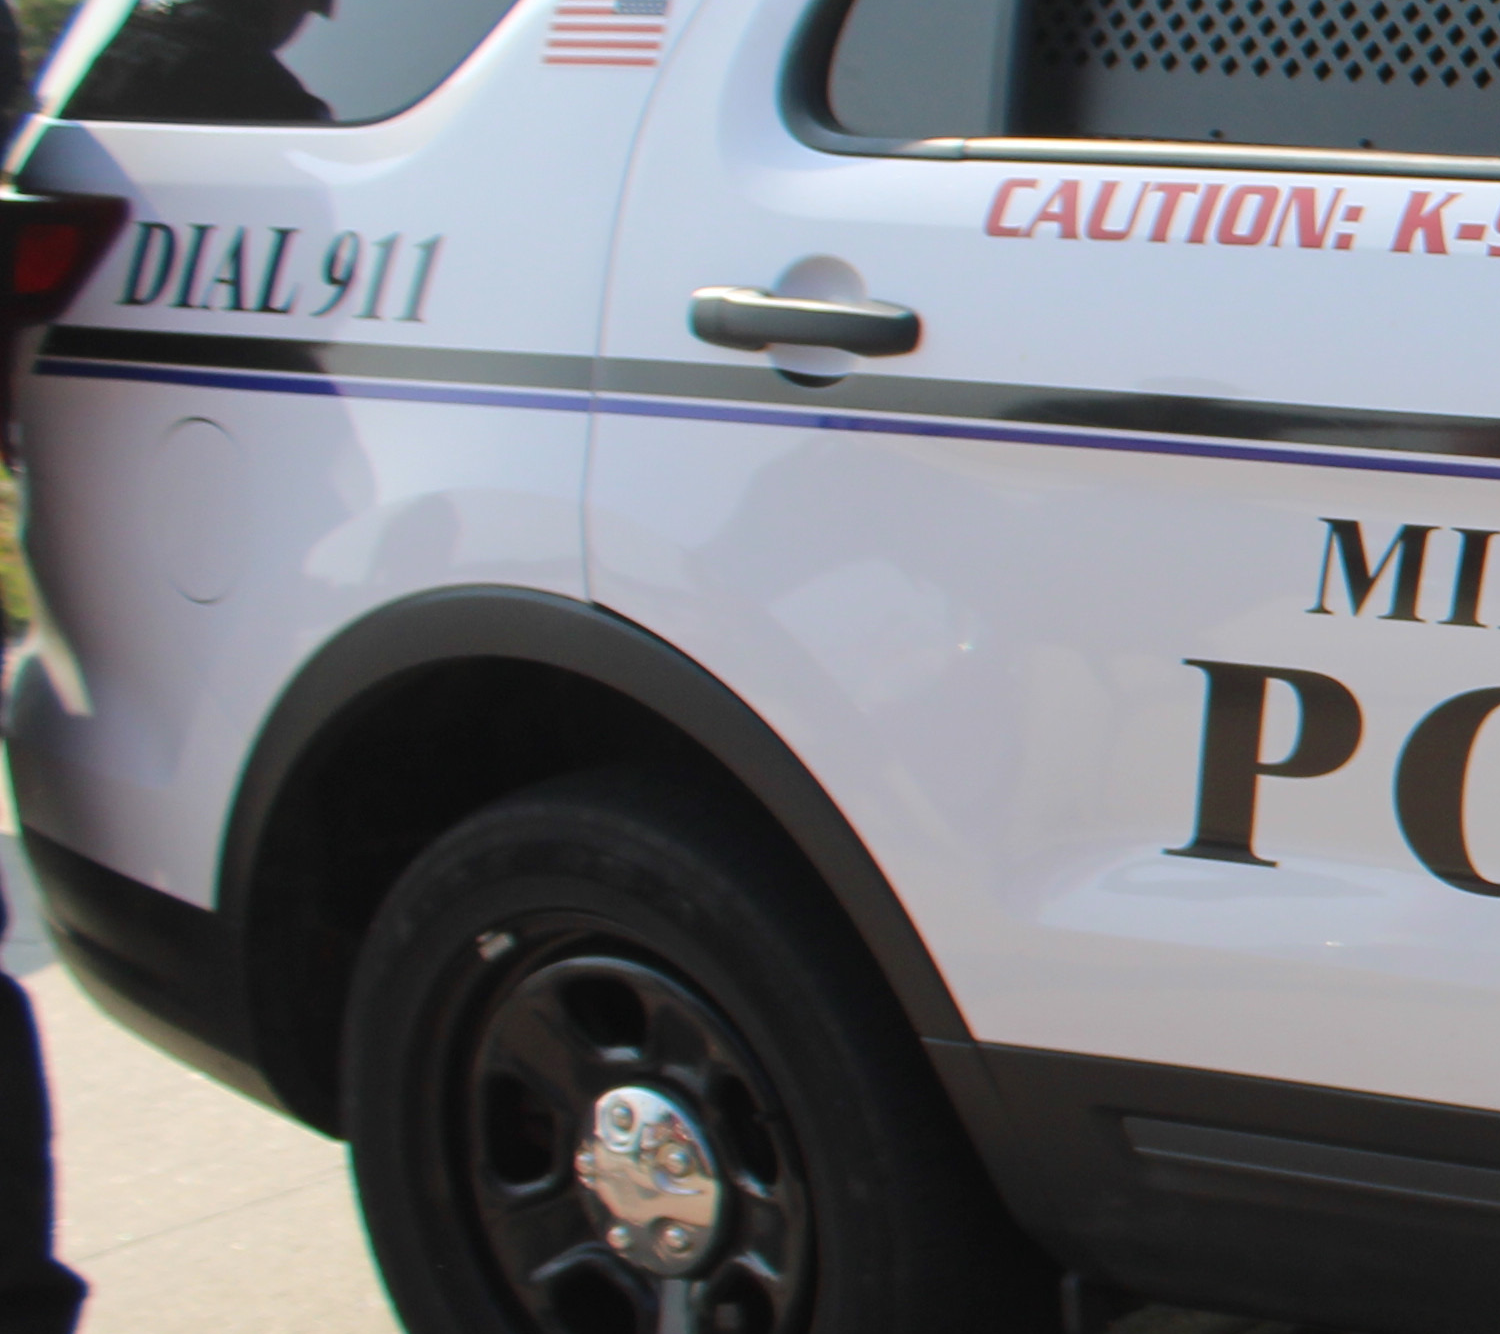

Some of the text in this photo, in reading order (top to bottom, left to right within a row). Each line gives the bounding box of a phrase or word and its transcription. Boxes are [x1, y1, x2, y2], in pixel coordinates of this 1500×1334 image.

[984, 178, 1365, 251] CAUTION:
[117, 220, 443, 323] DIAL 911
